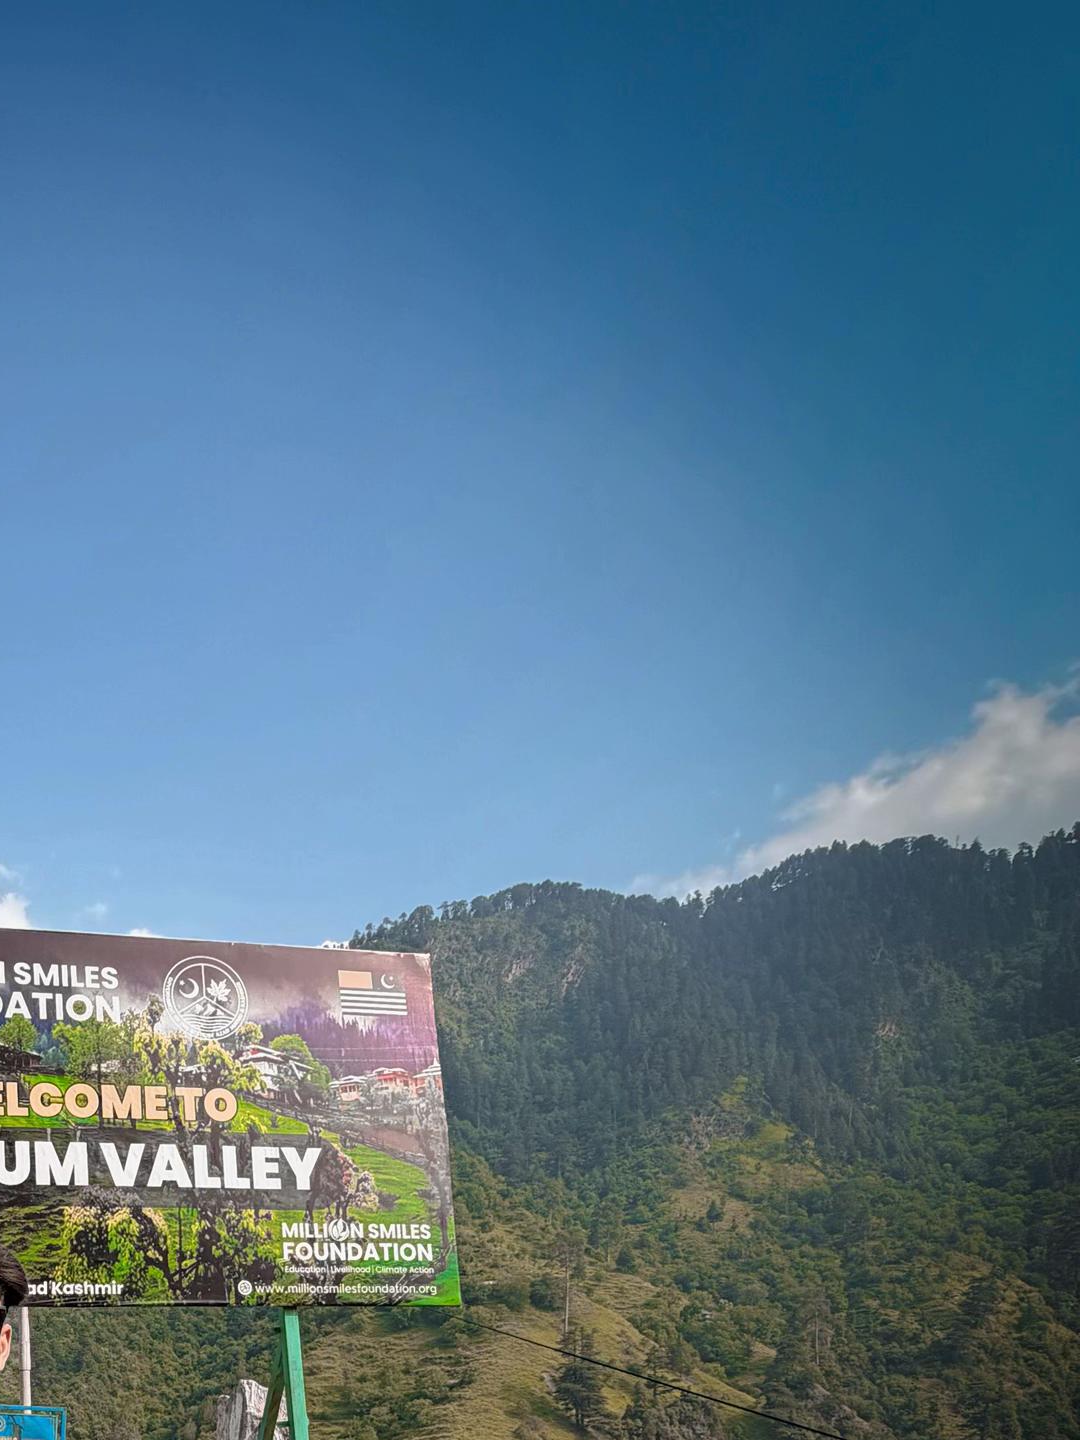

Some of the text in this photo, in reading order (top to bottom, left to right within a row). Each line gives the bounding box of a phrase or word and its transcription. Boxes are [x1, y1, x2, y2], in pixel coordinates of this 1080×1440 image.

[13, 962, 119, 990] SMILES
[175, 1086, 238, 1122] TO
[100, 1142, 322, 1190] VALLEY
[368, 1223, 432, 1240] SMILES
[282, 1241, 434, 1262] FOUNDATION
[284, 1265, 327, 1274] Education
[375, 1265, 408, 1274] Climate
[409, 1265, 435, 1274] Action
[27, 1280, 124, 1295] ad Kashmir
[255, 1283, 438, 1296] www.millionsmilesfoundation.org
